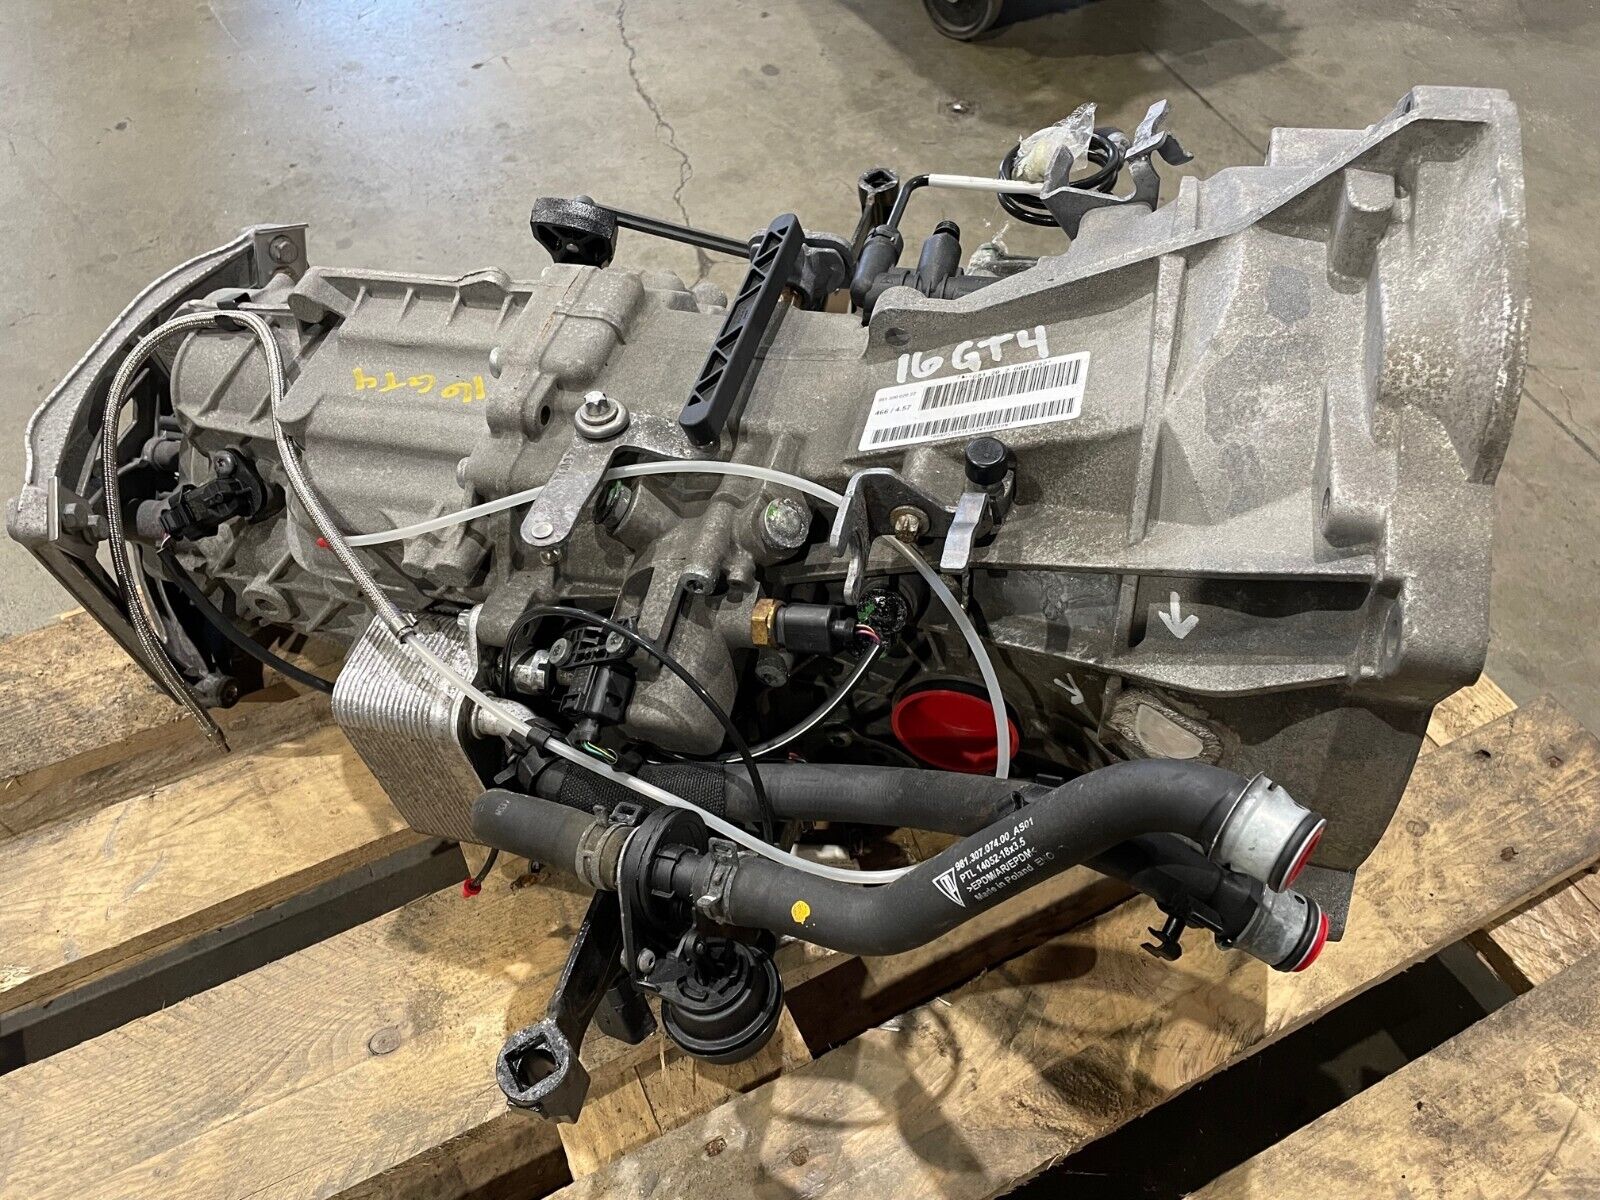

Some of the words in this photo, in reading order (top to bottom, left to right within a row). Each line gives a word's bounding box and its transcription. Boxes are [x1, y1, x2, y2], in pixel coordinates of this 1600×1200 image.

[897, 351, 944, 384] 16
[951, 325, 1049, 373] GT4
[352, 367, 436, 394] GT4
[441, 375, 486, 403] 16
[960, 869, 977, 883] PTL
[1003, 864, 1035, 884] Poland
